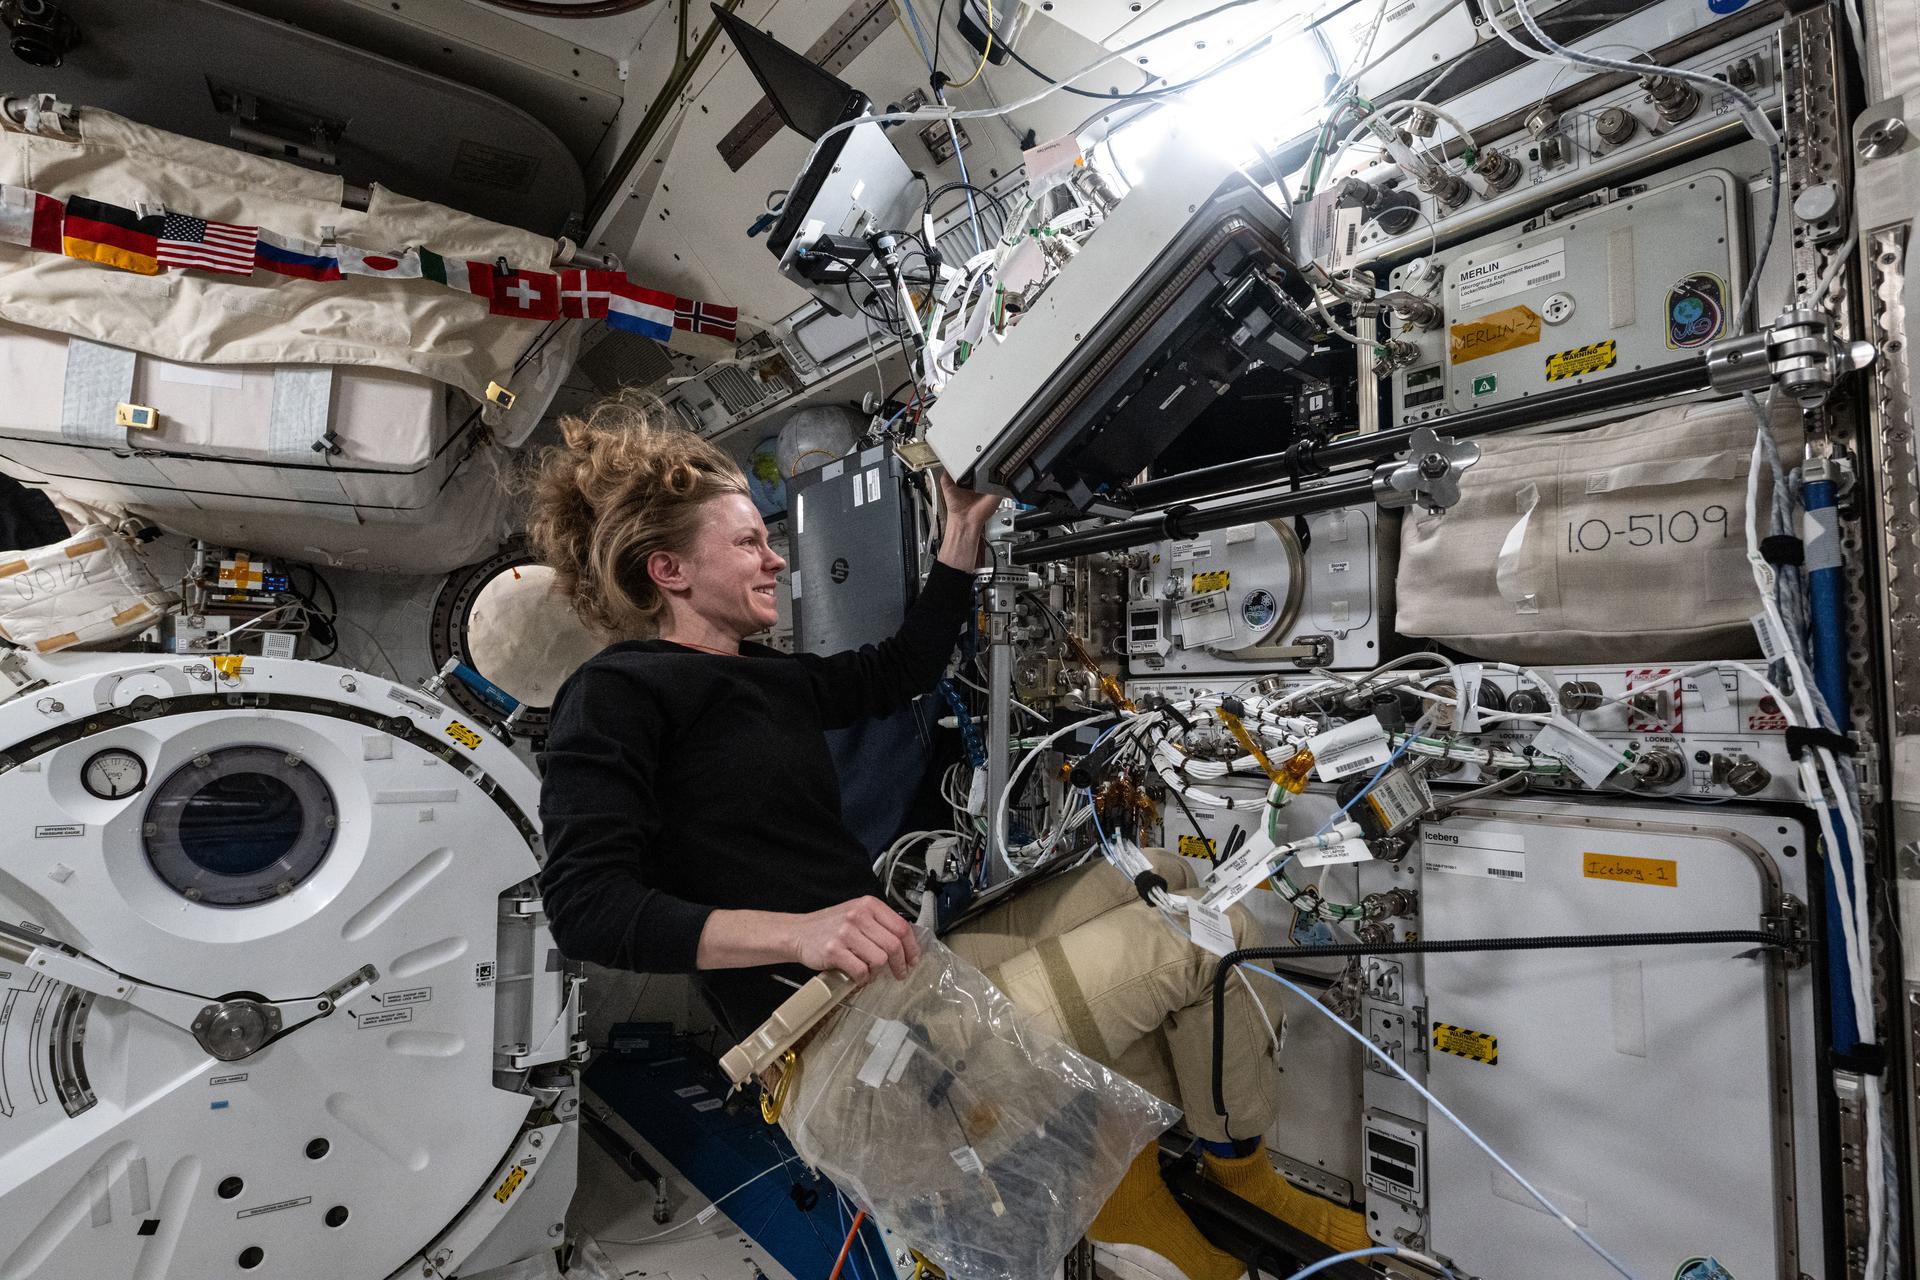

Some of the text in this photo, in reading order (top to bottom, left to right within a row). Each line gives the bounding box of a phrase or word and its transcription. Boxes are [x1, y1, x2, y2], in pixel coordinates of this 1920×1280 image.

[1716, 105, 1729, 116] D2
[1533, 176, 1543, 185] B2
[1460, 262, 1500, 281] MERLIN
[1493, 267, 1523, 283] Experiment
[1523, 259, 1550, 270] Research
[1454, 316, 1537, 350] MERLIN-2
[1562, 348, 1598, 361] WARNING
[1699, 786, 1710, 794] J2
[1425, 831, 1459, 844] Iceberg
[1587, 861, 1644, 881] Iceberg
[1656, 866, 1669, 880] 1
[1450, 1030, 1479, 1042] WARNING
